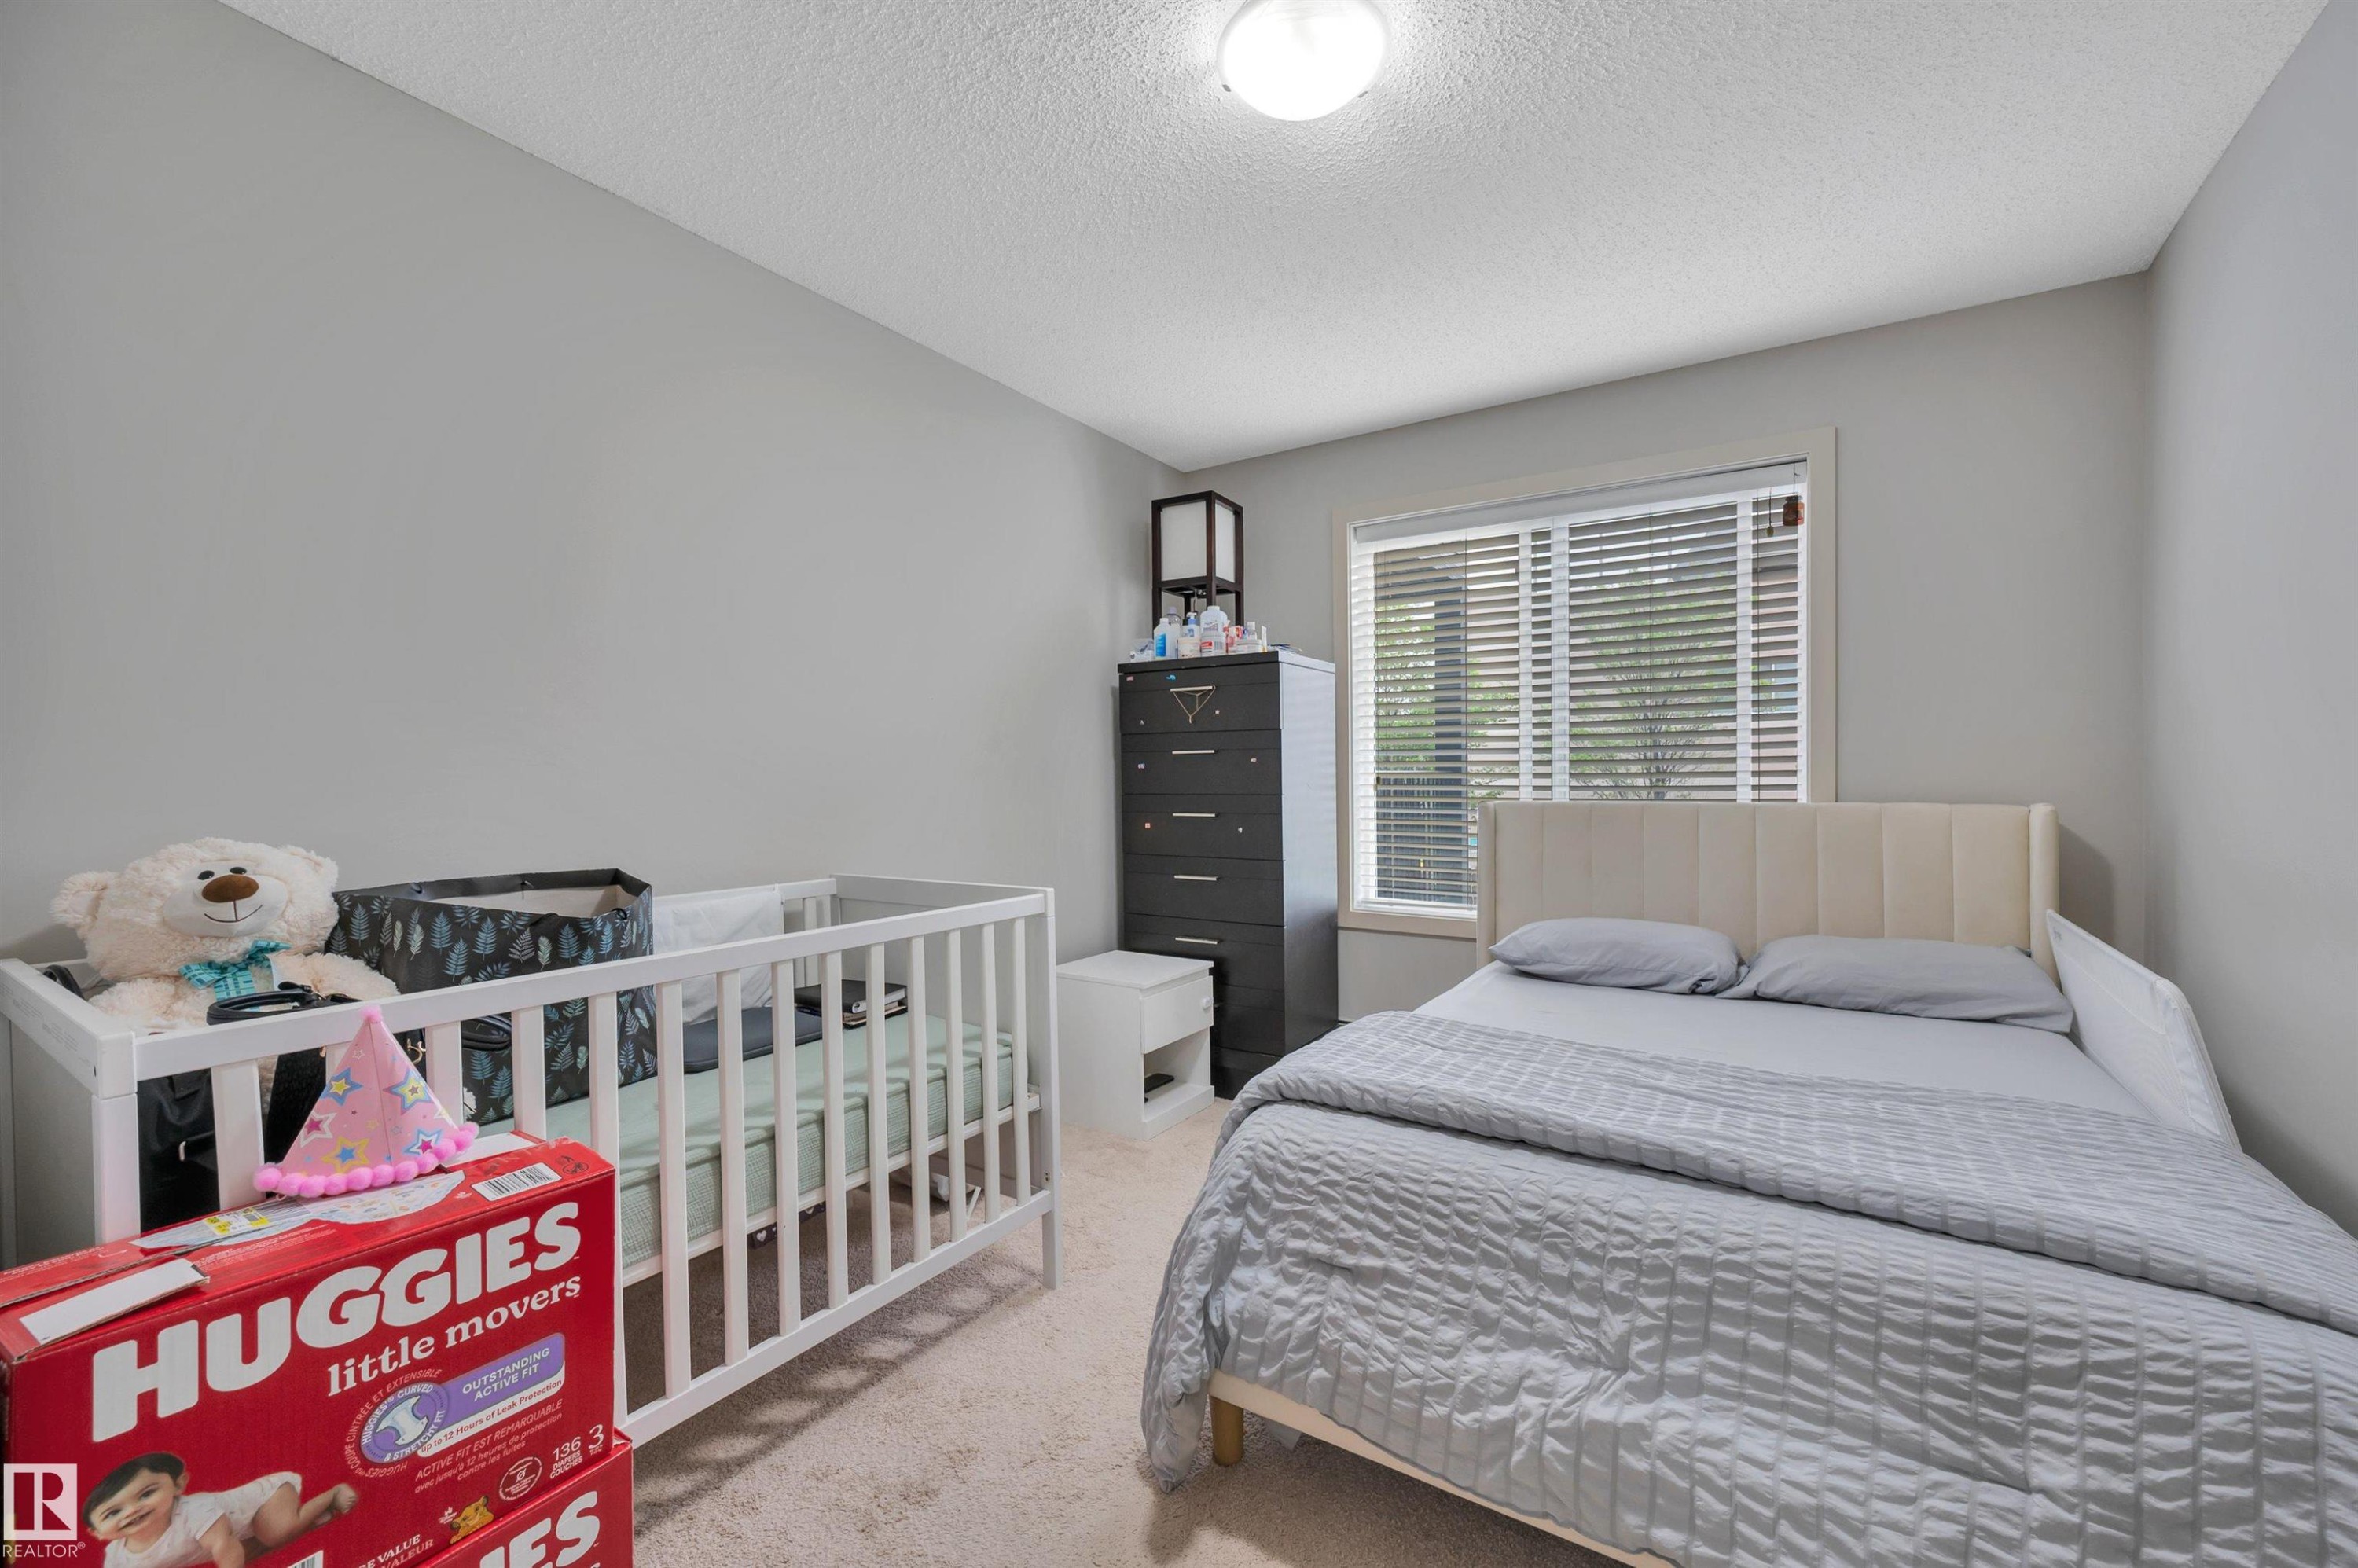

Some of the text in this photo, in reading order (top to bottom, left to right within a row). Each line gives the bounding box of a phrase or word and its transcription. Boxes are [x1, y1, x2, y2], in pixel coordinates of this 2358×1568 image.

[93, 1202, 581, 1443] HUGGIES
[327, 1276, 581, 1397] little movers
[386, 1368, 443, 1393] EXTENSIBLE
[462, 1348, 550, 1394] OUTSTANDING
[474, 1363, 539, 1401] ACTIVE FIT
[373, 1389, 384, 1403] ET
[397, 1383, 434, 1399] CURVED
[346, 1401, 373, 1443] CINTRÉE
[421, 1379, 562, 1453] up to 12 Hours of Leak Protection
[434, 1410, 446, 1423] FIT
[393, 1424, 438, 1461] STRETCHY
[415, 1399, 563, 1482] ACTIVE FIT EST REMARQUABLE
[553, 1436, 582, 1461] 136
[589, 1423, 604, 1449] 3
[344, 1442, 361, 1469] COUPE
[384, 1452, 391, 1462] &
[415, 1478, 434, 1493] avec
[467, 1457, 476, 1467] 12
[478, 1444, 507, 1460] heures
[509, 1434, 519, 1444] de
[520, 1413, 562, 1441] protection
[457, 1440, 526, 1482] contre les fuites
[550, 1456, 583, 1479] COUCHES
[553, 1450, 581, 1471] DIAPERS
[377, 1533, 421, 1562] VALUE
